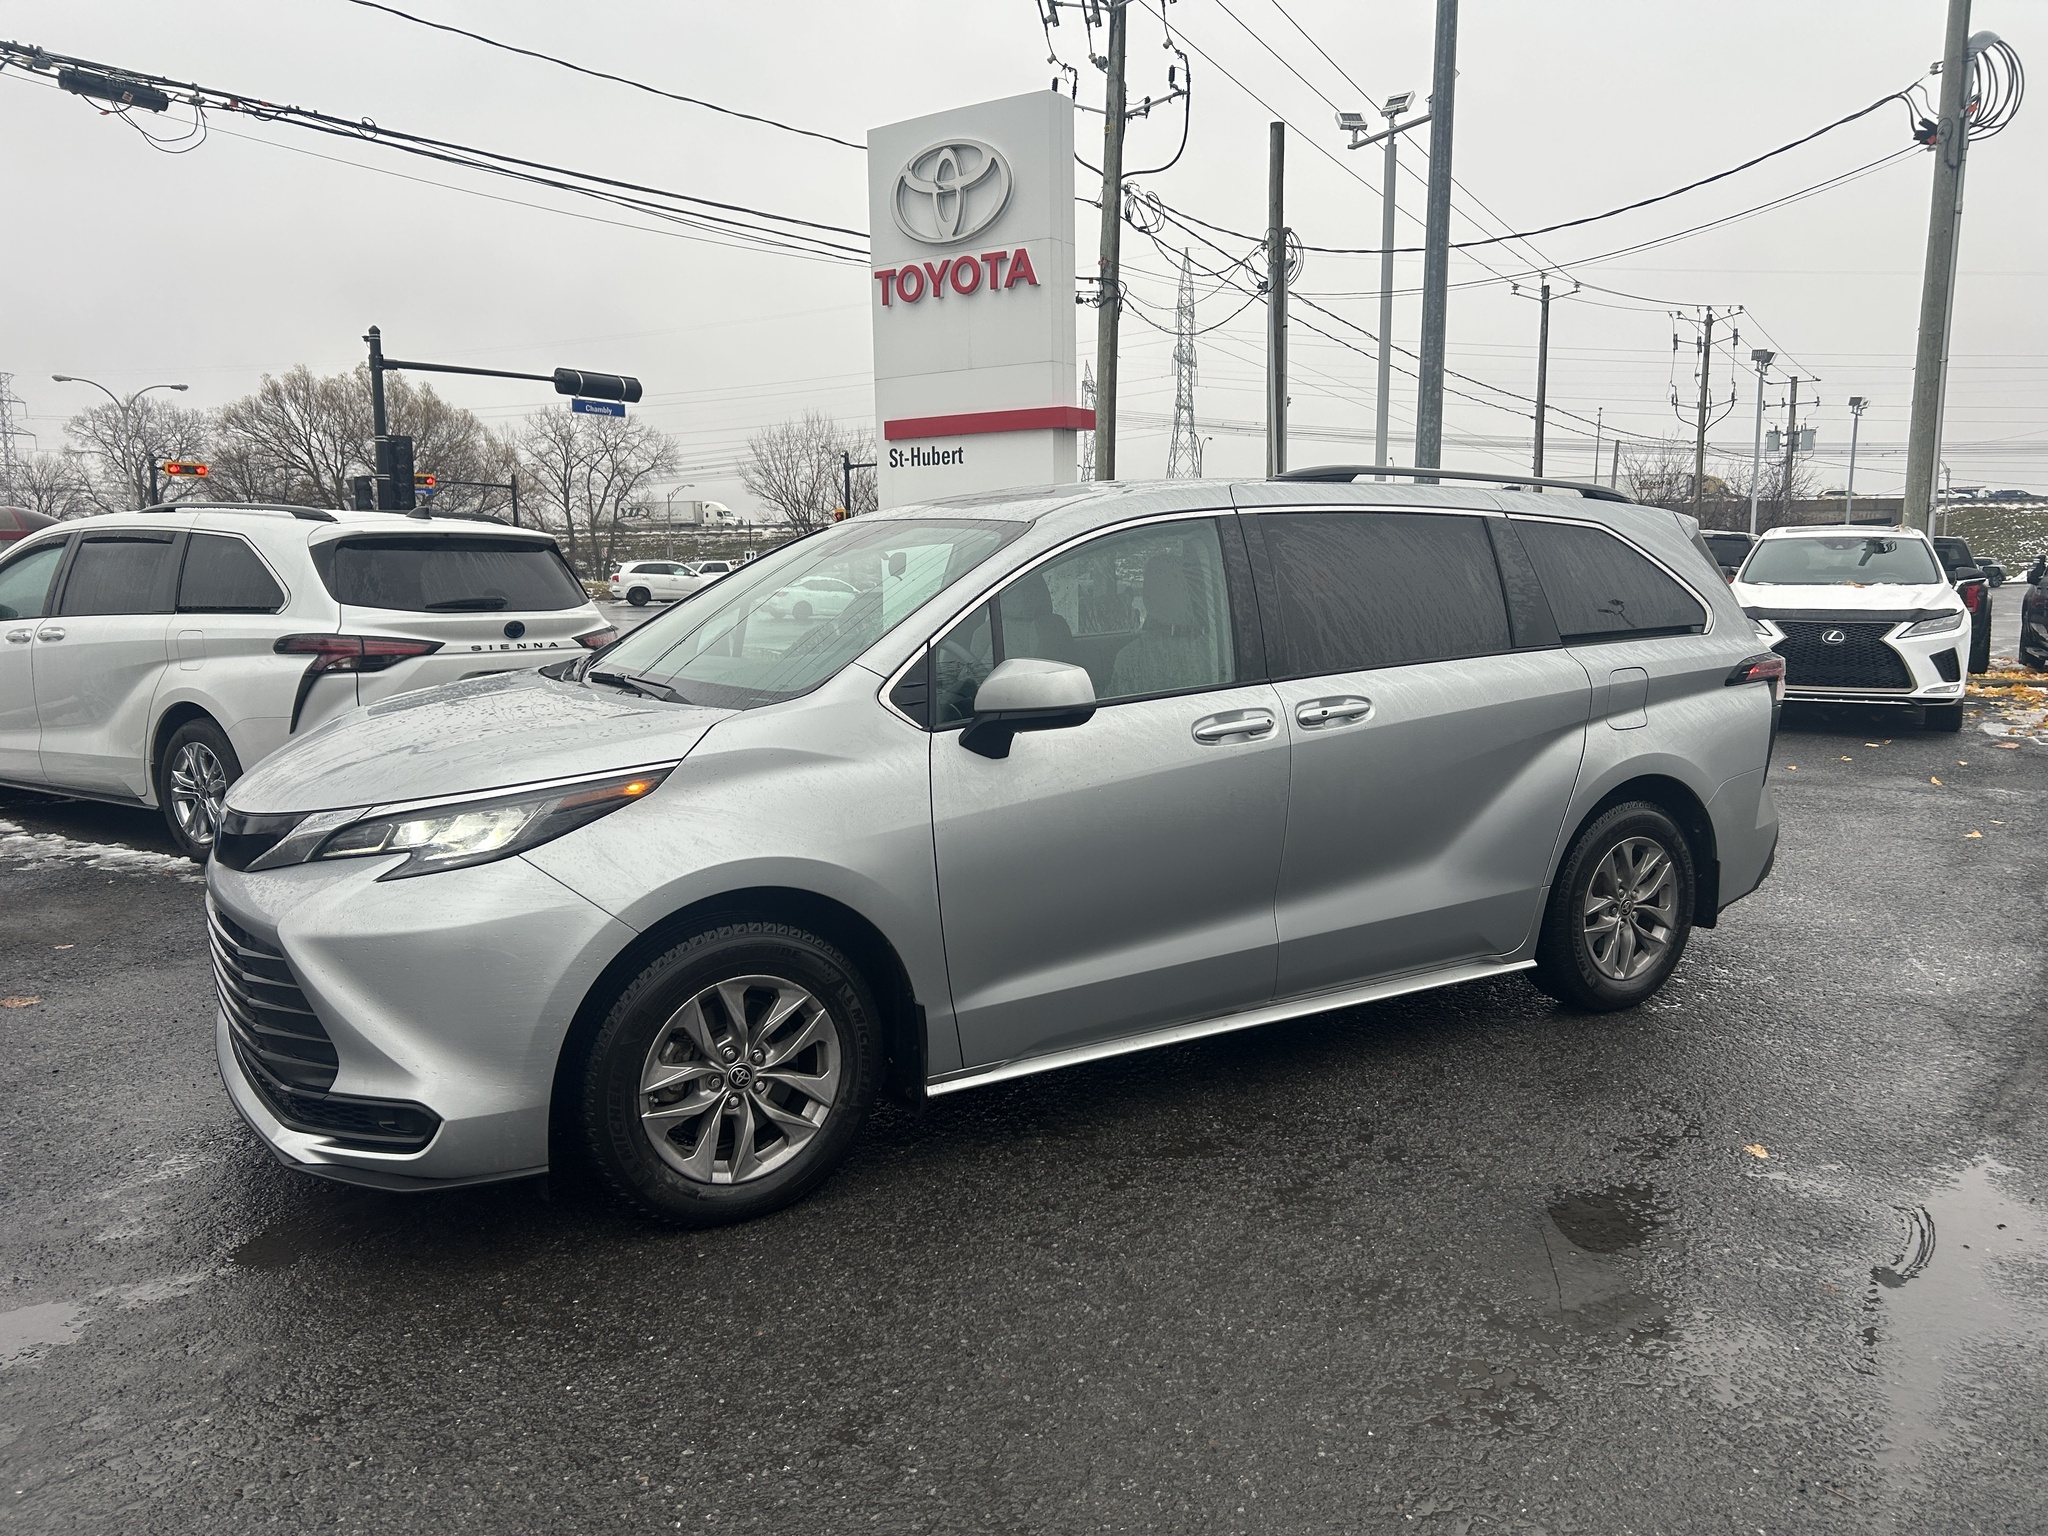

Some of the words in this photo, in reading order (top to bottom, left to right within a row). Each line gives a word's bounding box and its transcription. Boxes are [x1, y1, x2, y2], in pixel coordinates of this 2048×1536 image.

[874, 248, 1038, 306] TOYOTA
[585, 404, 612, 415] Chambly
[889, 446, 964, 468] St-Hubert
[471, 642, 558, 651] SIENNA
